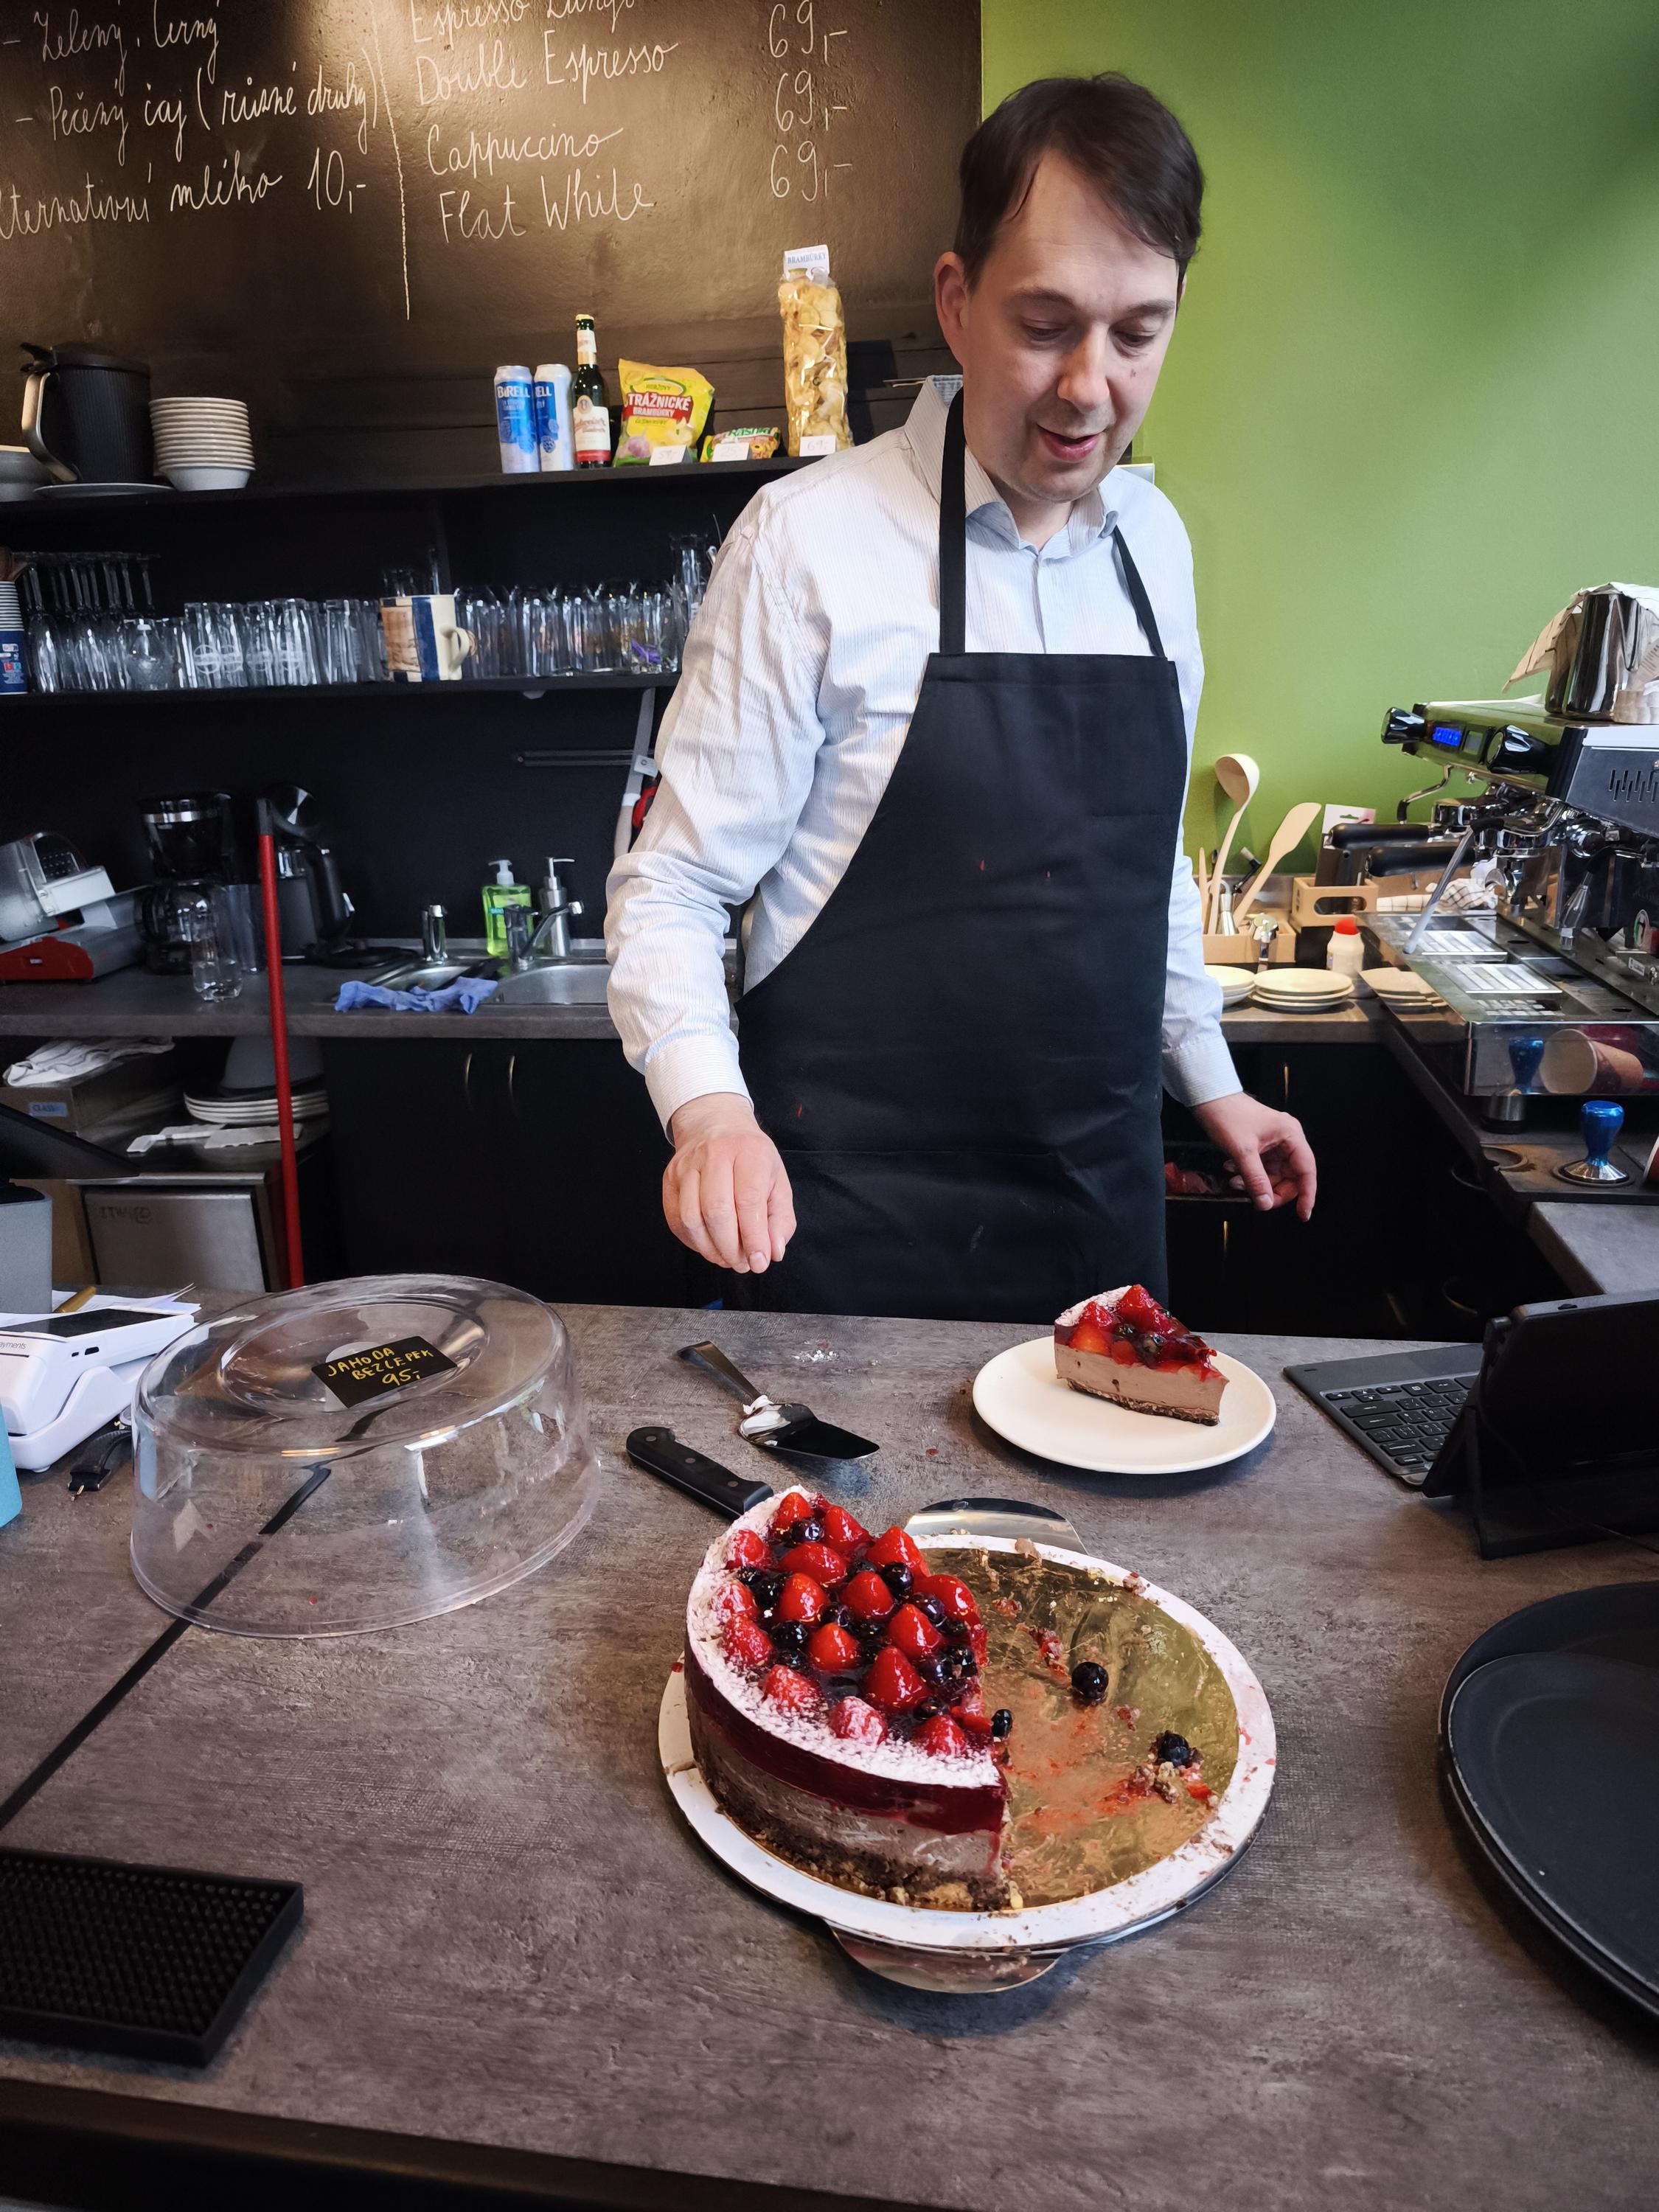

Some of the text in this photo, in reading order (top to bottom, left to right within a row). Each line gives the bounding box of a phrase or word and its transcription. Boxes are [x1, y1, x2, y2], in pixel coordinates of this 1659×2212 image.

[416, 29, 679, 105] Double Espresso
[50, 78, 128, 167] Pečený
[427, 124, 624, 178] Cappuccino
[0, 161, 151, 240] lternativní
[170, 150, 283, 212] mléko
[439, 167, 655, 243] Flat White
[327, 1347, 395, 1377] JAHODA
